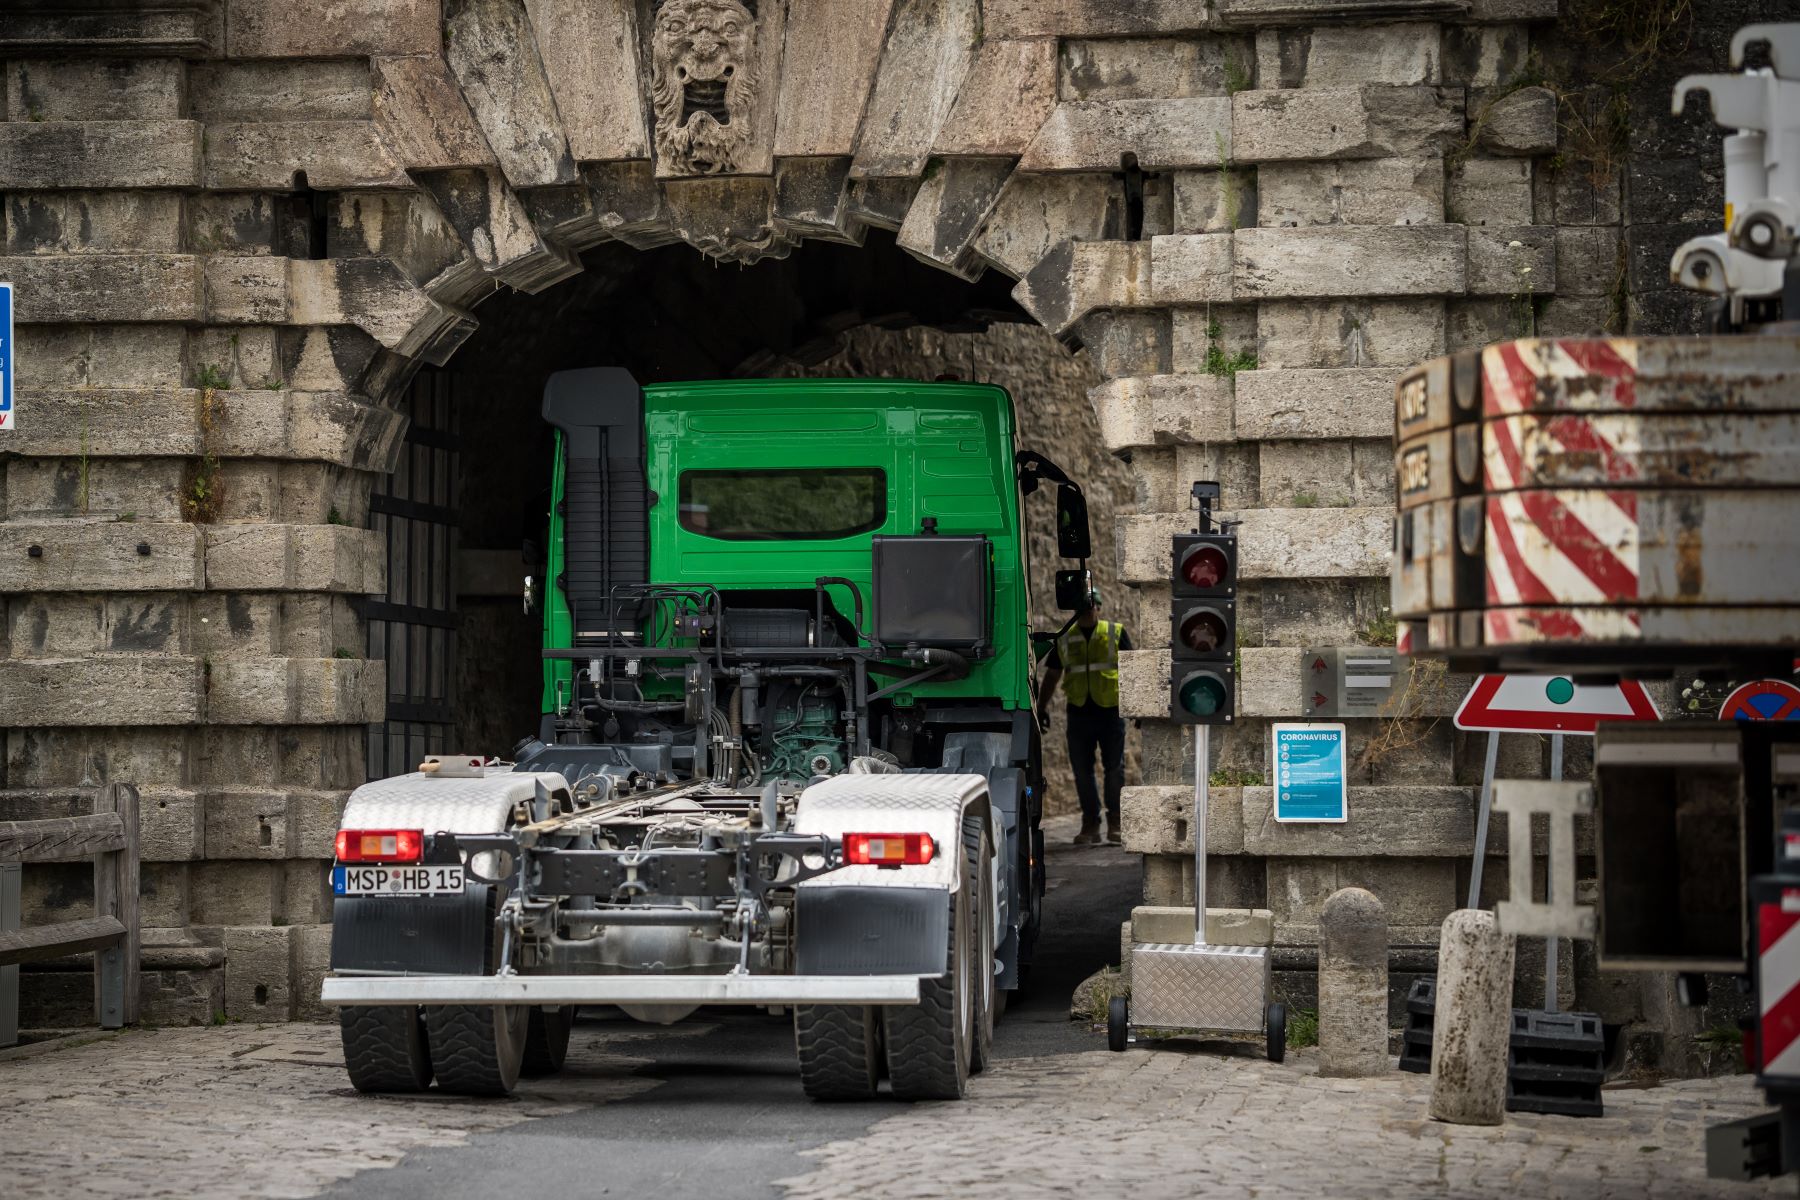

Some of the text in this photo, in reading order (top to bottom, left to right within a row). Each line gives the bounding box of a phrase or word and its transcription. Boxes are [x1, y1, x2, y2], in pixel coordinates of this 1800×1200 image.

[1281, 733, 1338, 741] CORONAVIRUS
[347, 869, 462, 890] MSP HB 15
